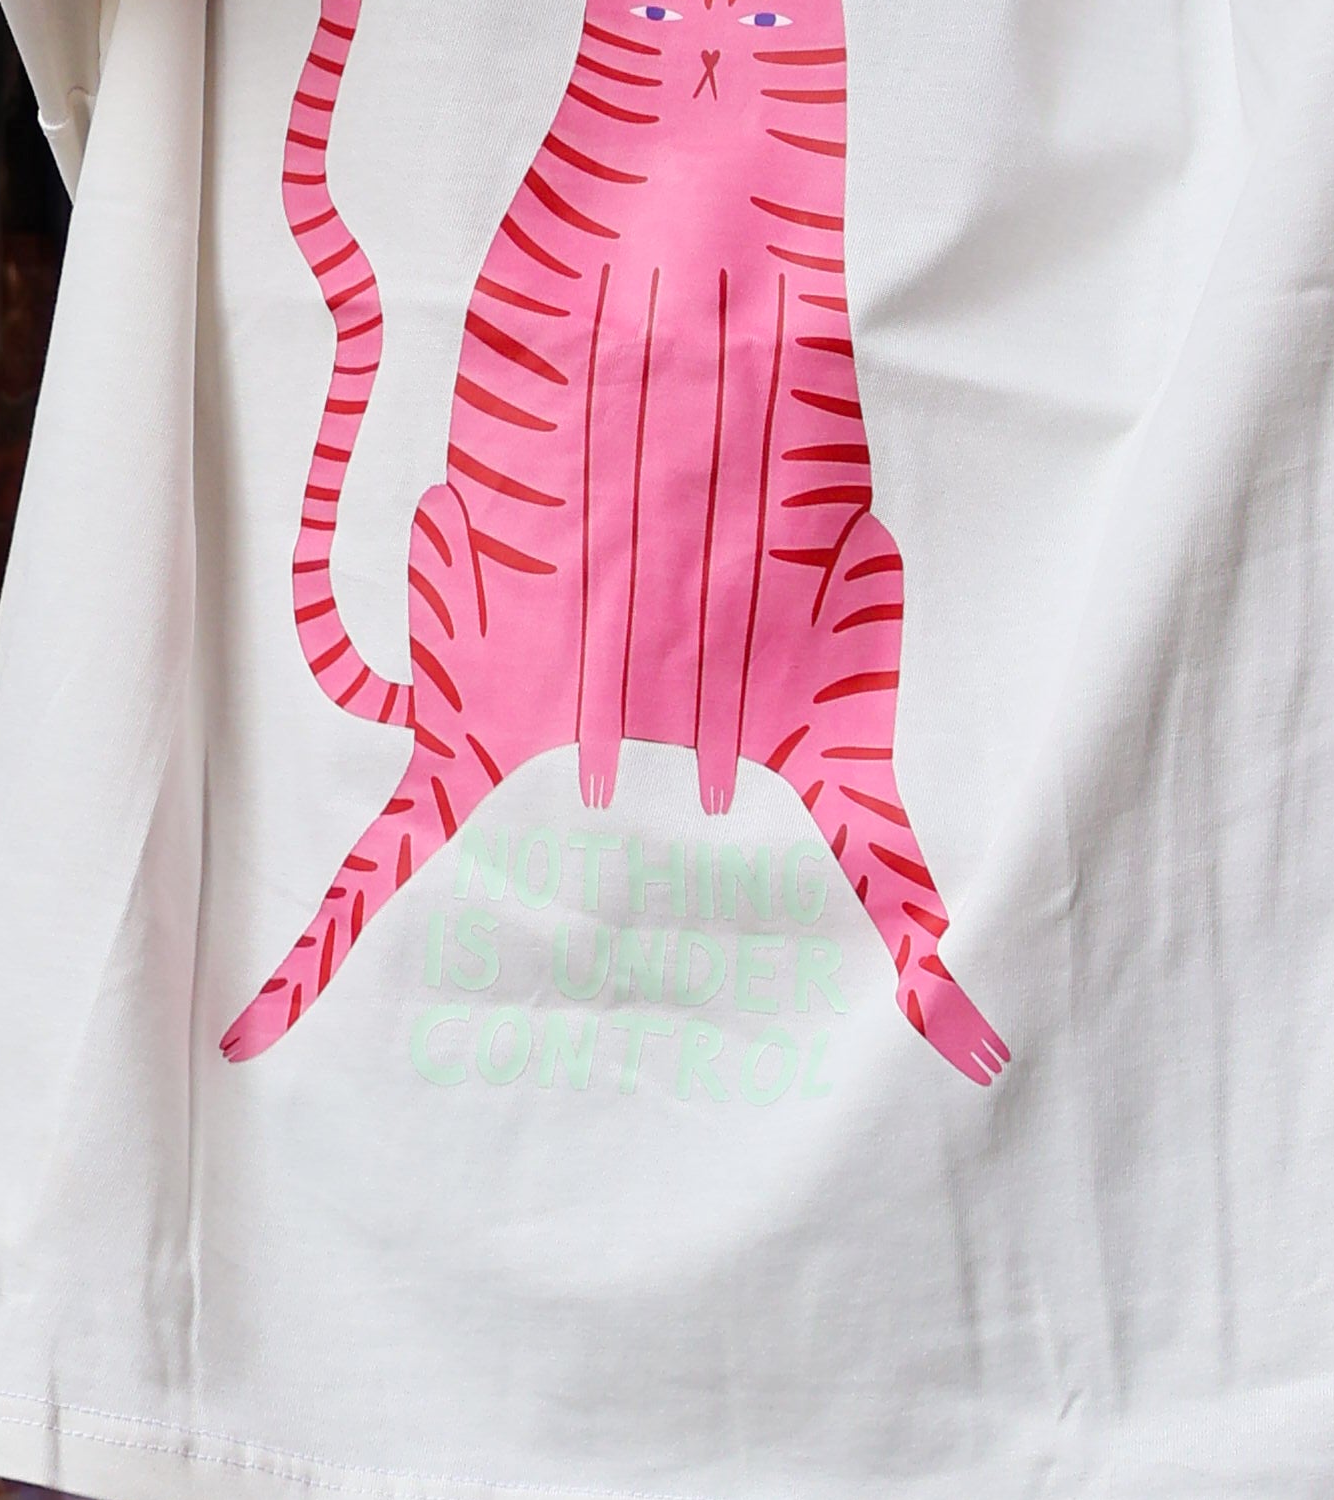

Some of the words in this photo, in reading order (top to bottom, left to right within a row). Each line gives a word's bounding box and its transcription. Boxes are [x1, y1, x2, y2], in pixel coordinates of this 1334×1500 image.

[454, 823, 828, 924] NOTHING
[422, 907, 501, 992] IS
[551, 923, 851, 1015] UNDER
[407, 1003, 835, 1107] CONTROL
